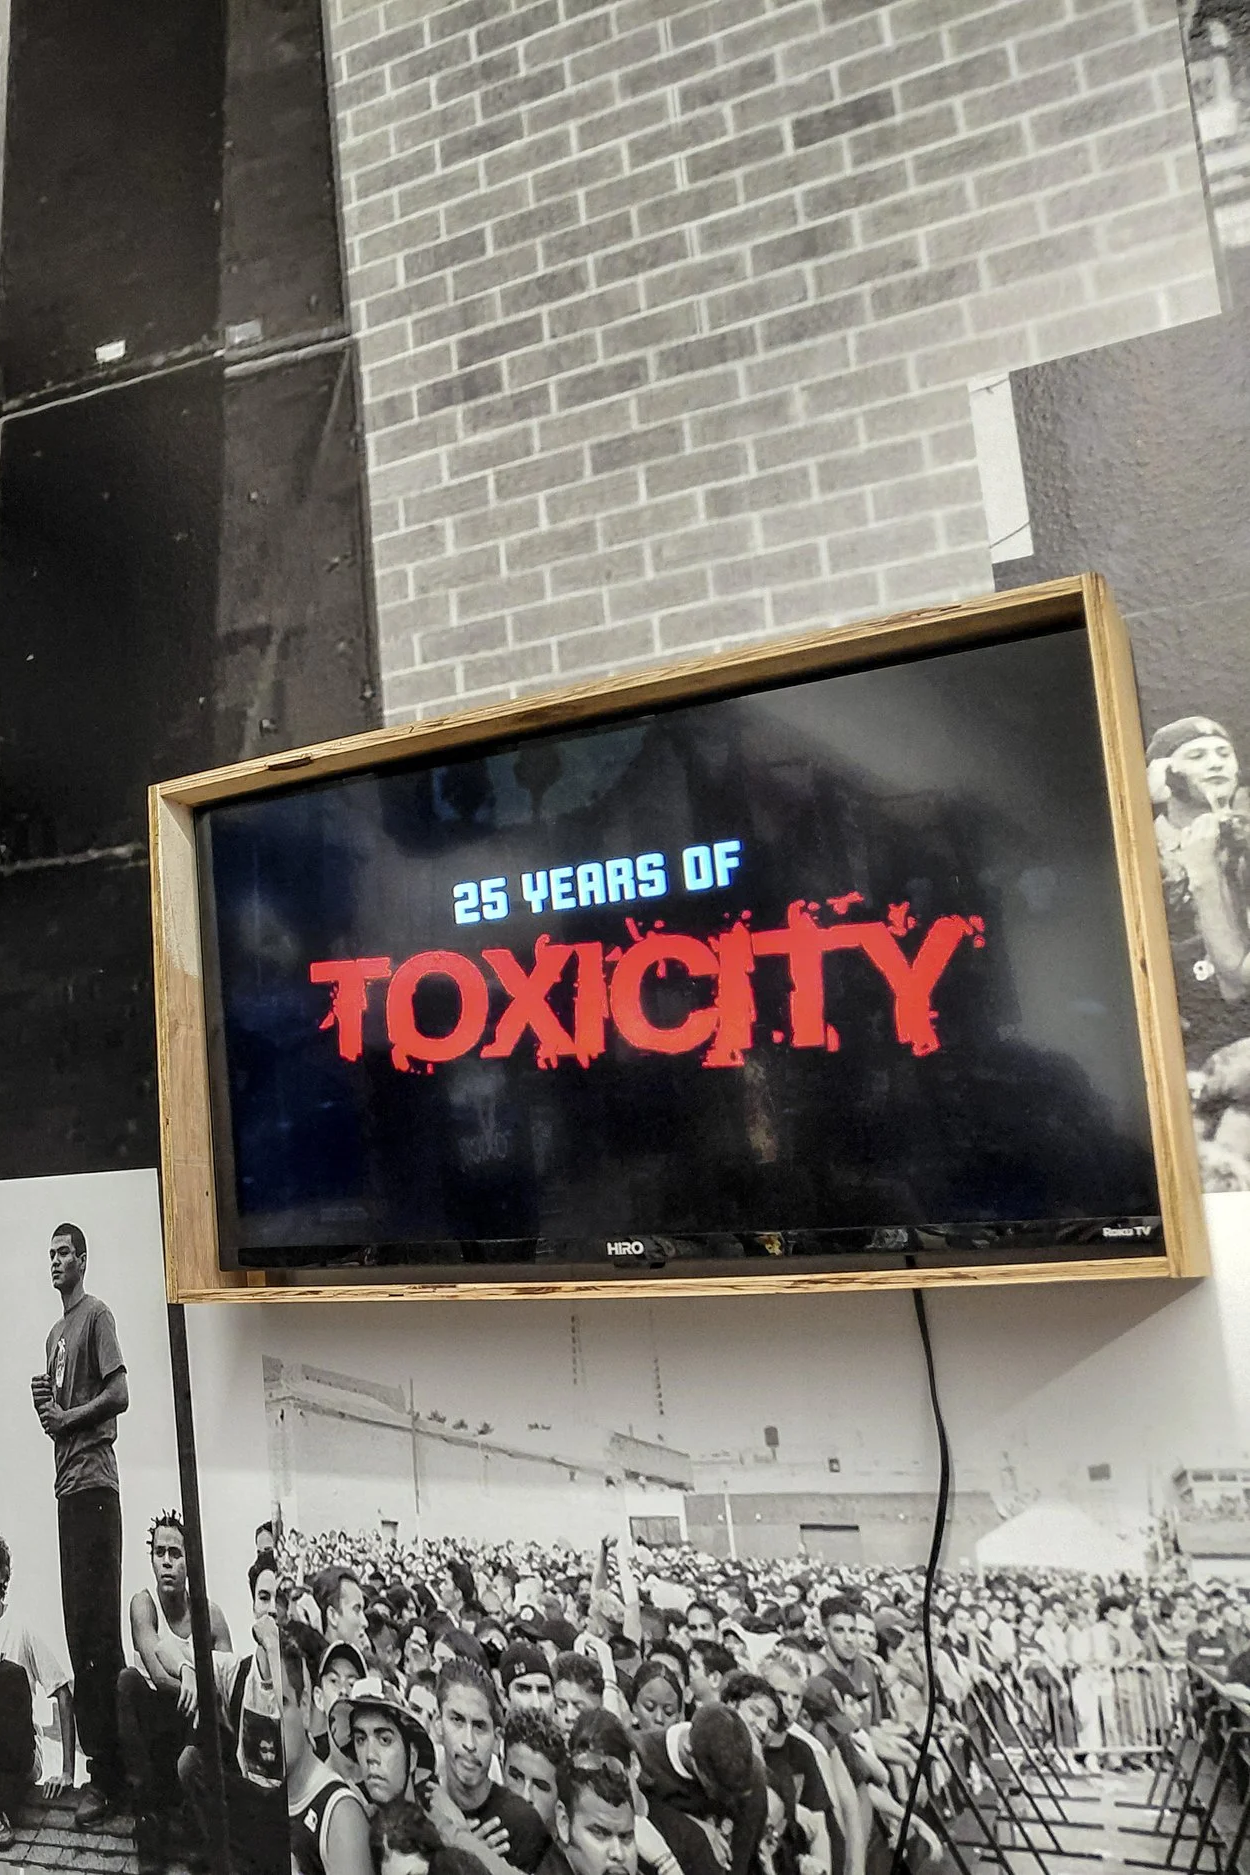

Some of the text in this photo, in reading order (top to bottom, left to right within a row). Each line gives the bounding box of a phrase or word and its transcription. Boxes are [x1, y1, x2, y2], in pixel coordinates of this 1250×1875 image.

[452, 840, 743, 925] 25 YEARS OF
[309, 892, 986, 1074] TOXICITY
[606, 1240, 645, 1256] HIRO
[1134, 1226, 1152, 1236] TV
